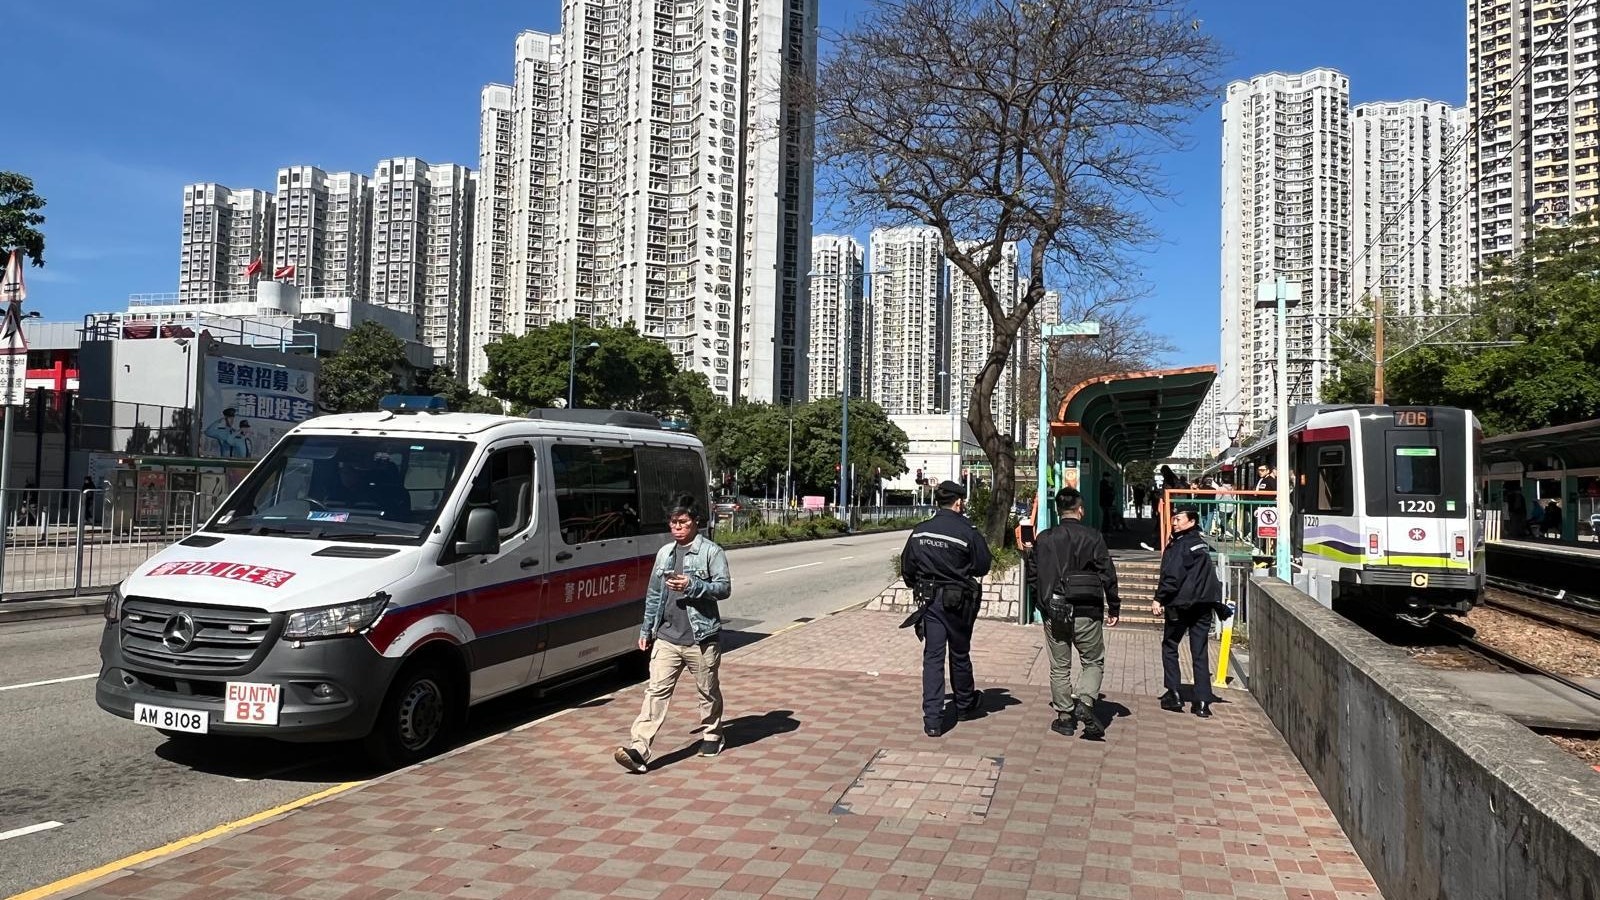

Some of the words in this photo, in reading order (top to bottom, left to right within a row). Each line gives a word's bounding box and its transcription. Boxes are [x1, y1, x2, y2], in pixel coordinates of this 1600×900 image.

[217, 361, 289, 392] 警察招募
[1394, 411, 1427, 426] 706
[1398, 500, 1436, 513] 1220
[1304, 516, 1320, 527] 1220
[169, 562, 265, 582] POLICE
[1413, 574, 1426, 587] C
[578, 574, 616, 600] POLICE
[139, 707, 157, 724] AM
[164, 711, 201, 729] 8108
[236, 702, 265, 721] 83
